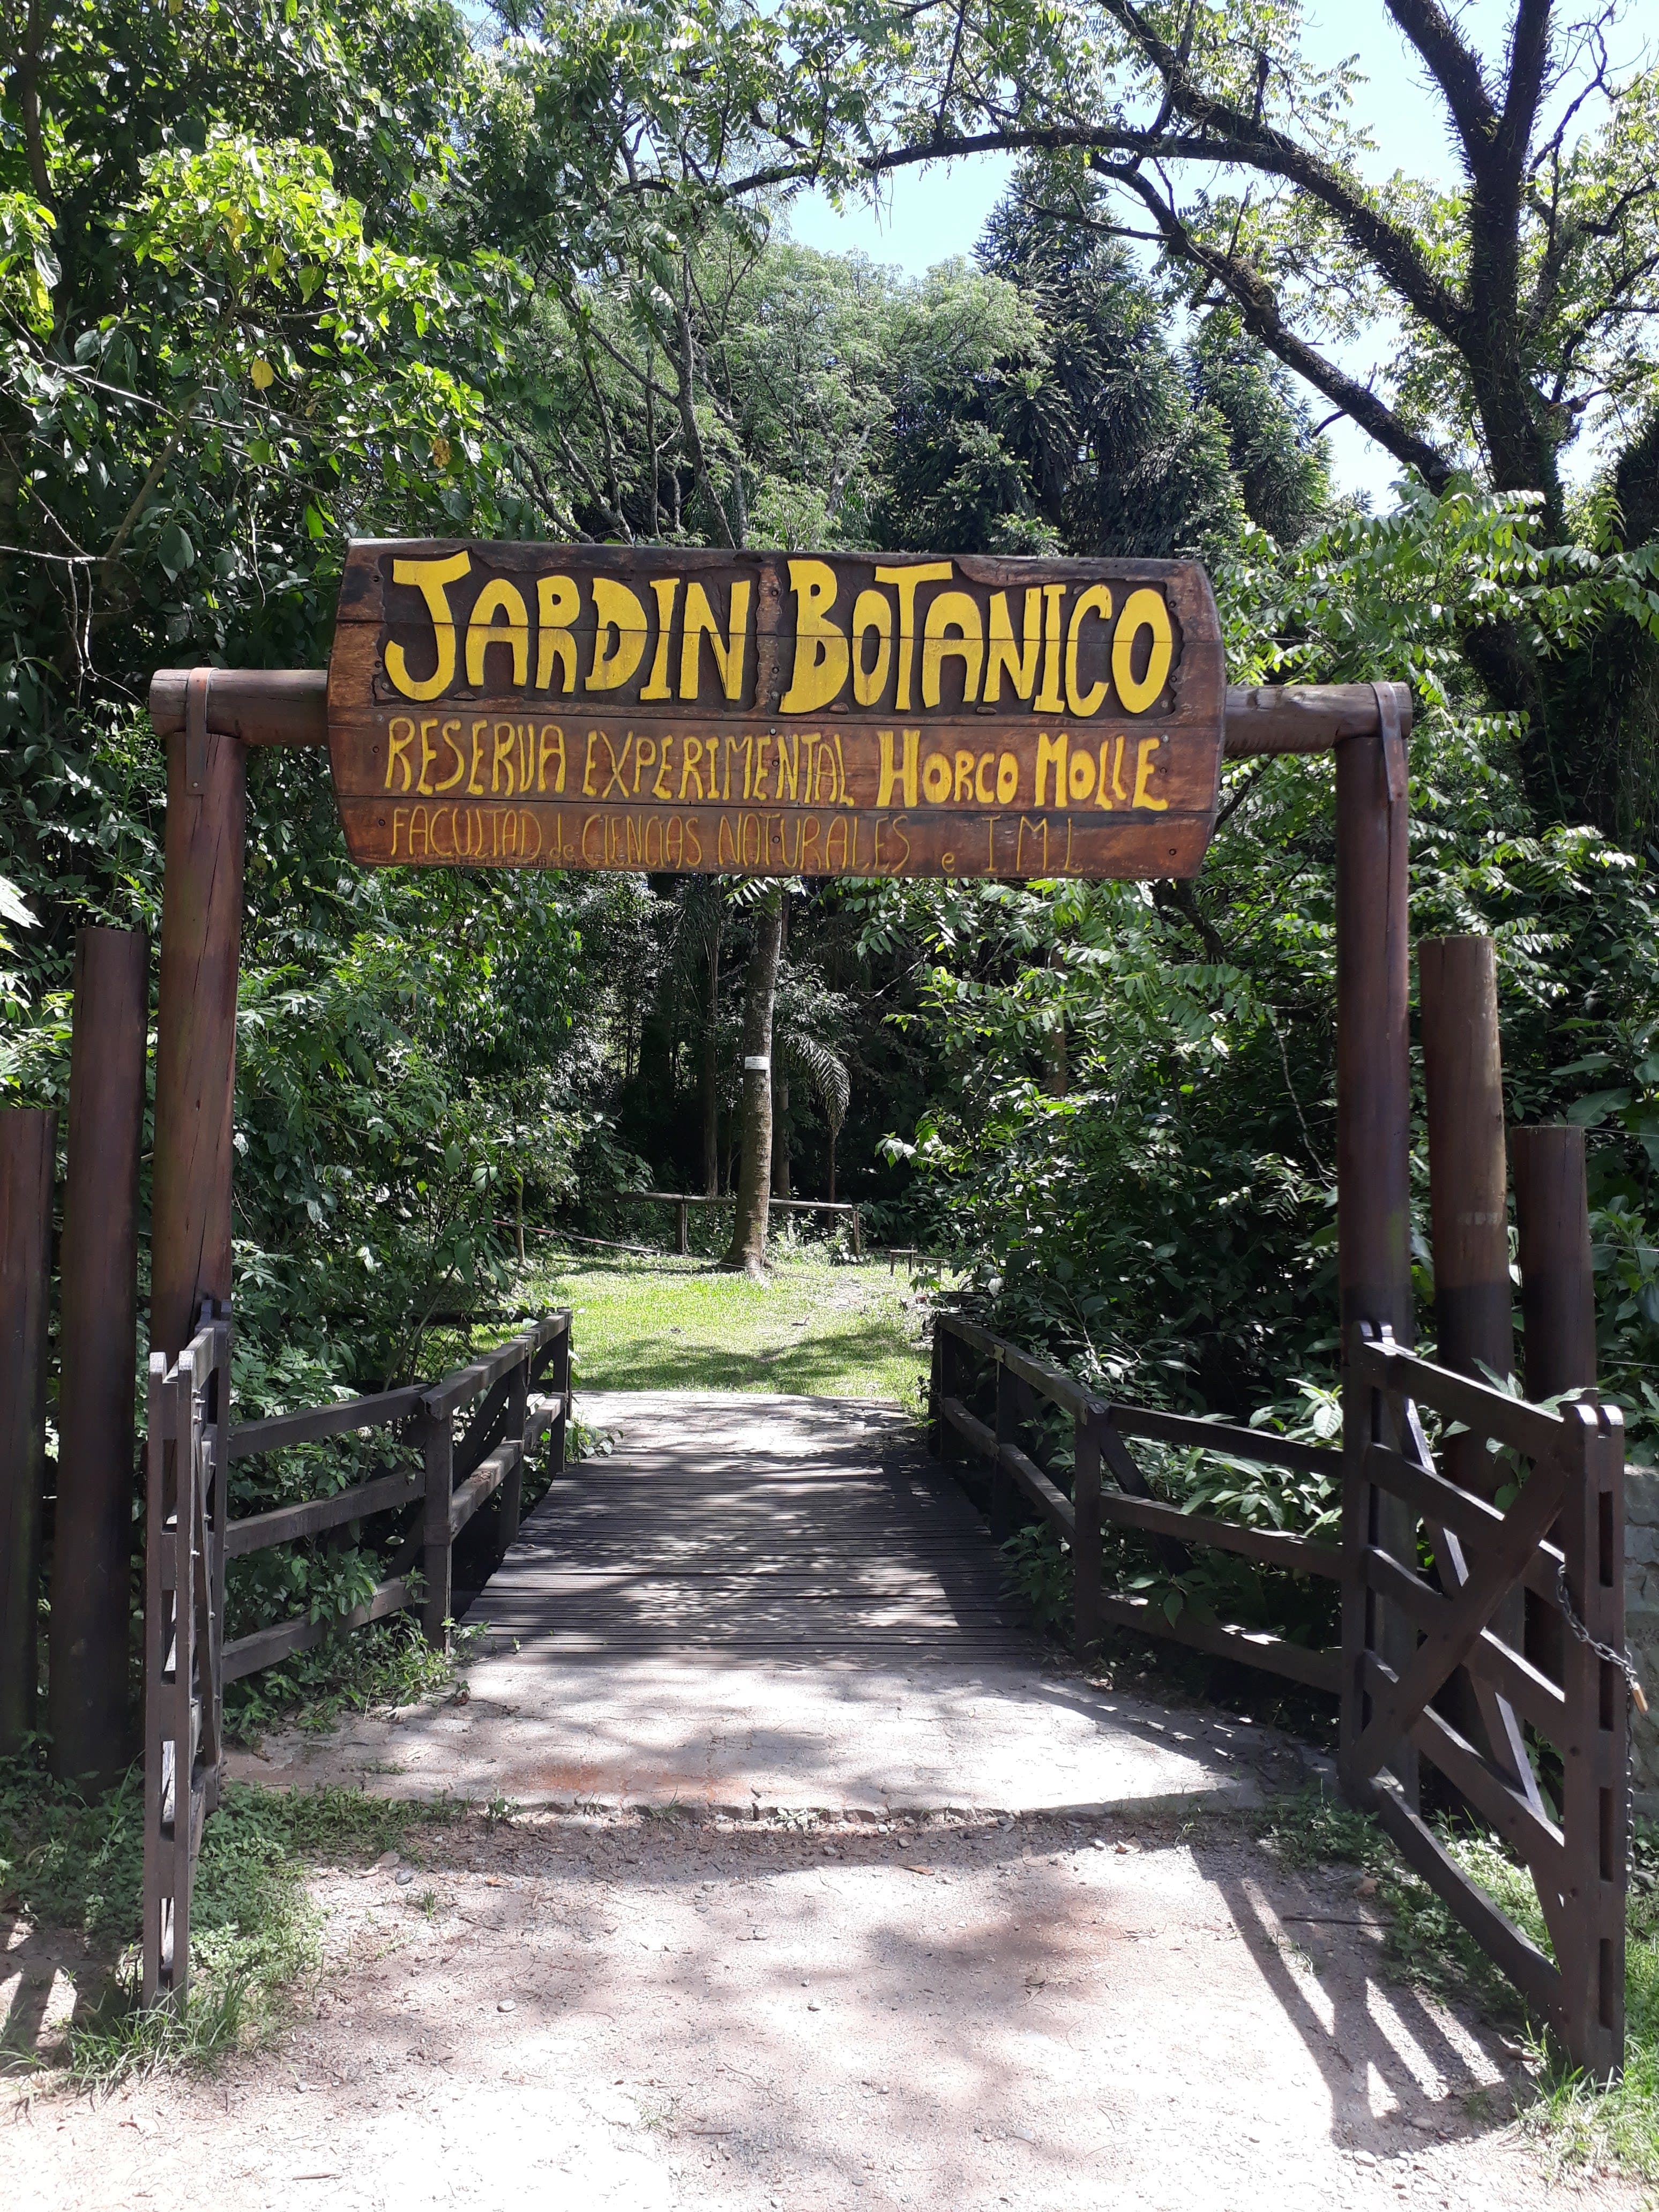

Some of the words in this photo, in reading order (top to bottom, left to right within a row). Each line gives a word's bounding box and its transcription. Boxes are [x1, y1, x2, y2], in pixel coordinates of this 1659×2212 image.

[384, 550, 750, 701] JARDIN
[779, 560, 1173, 717] BOTANICO
[384, 716, 566, 797] RESERVA
[581, 729, 855, 806] EXPERIMENTAL
[876, 729, 1019, 808] HORCO
[1035, 732, 1169, 811] MOLLE
[391, 805, 542, 861] FACULTAD
[549, 812, 575, 858] de
[582, 813, 703, 869] CIENCIAS
[719, 811, 911, 873] NATURALES
